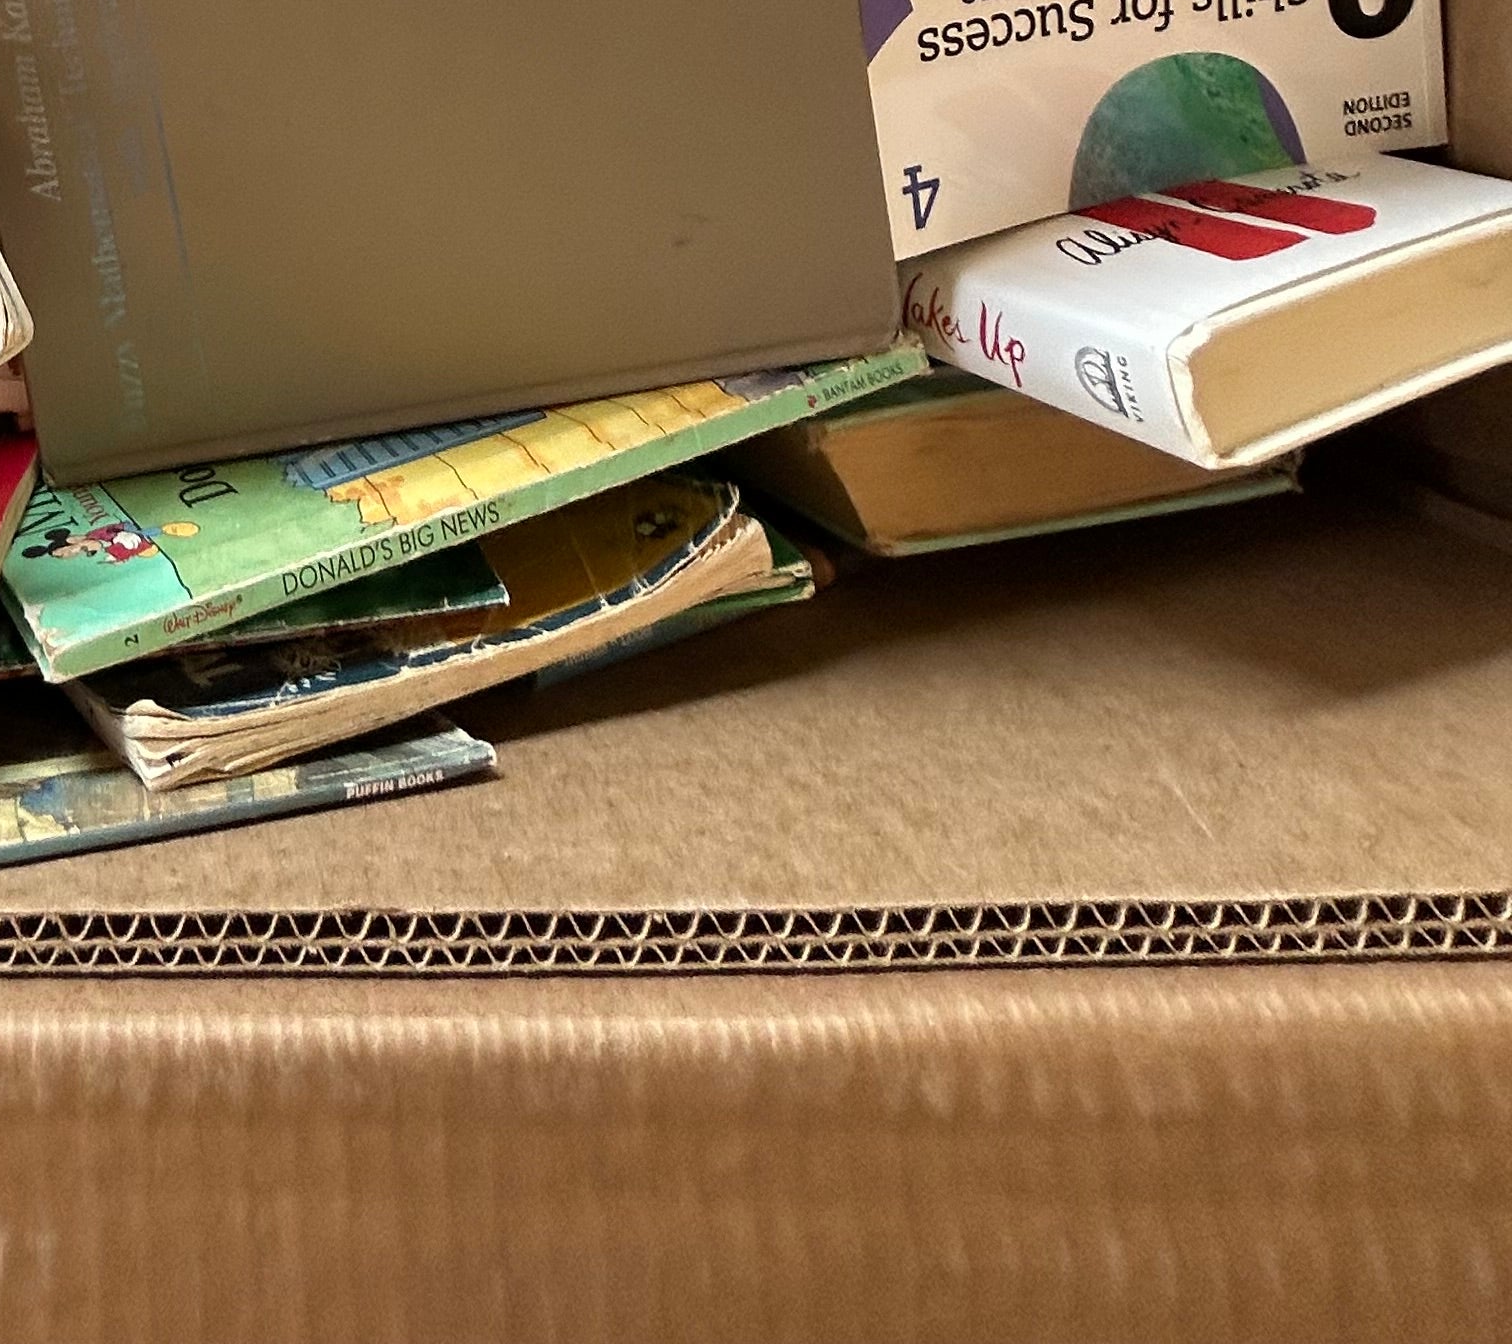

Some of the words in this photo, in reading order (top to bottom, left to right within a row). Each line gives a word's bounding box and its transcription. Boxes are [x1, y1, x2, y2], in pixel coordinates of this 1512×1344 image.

[10, 55, 61, 206] Abraham
[1342, 90, 1412, 115] EDITION
[1344, 113, 1413, 137] SECOND
[901, 164, 941, 232] 4
[952, 301, 1037, 387] Up
[822, 374, 866, 401] BANTAM
[865, 361, 905, 386] BOOKS
[1117, 356, 1143, 421] VIKING
[278, 537, 394, 596] DONALD'S
[396, 522, 434, 554] BIG
[437, 501, 499, 540] NEWS
[344, 777, 396, 799] PUFFIN
[395, 769, 444, 789] BOOKS
